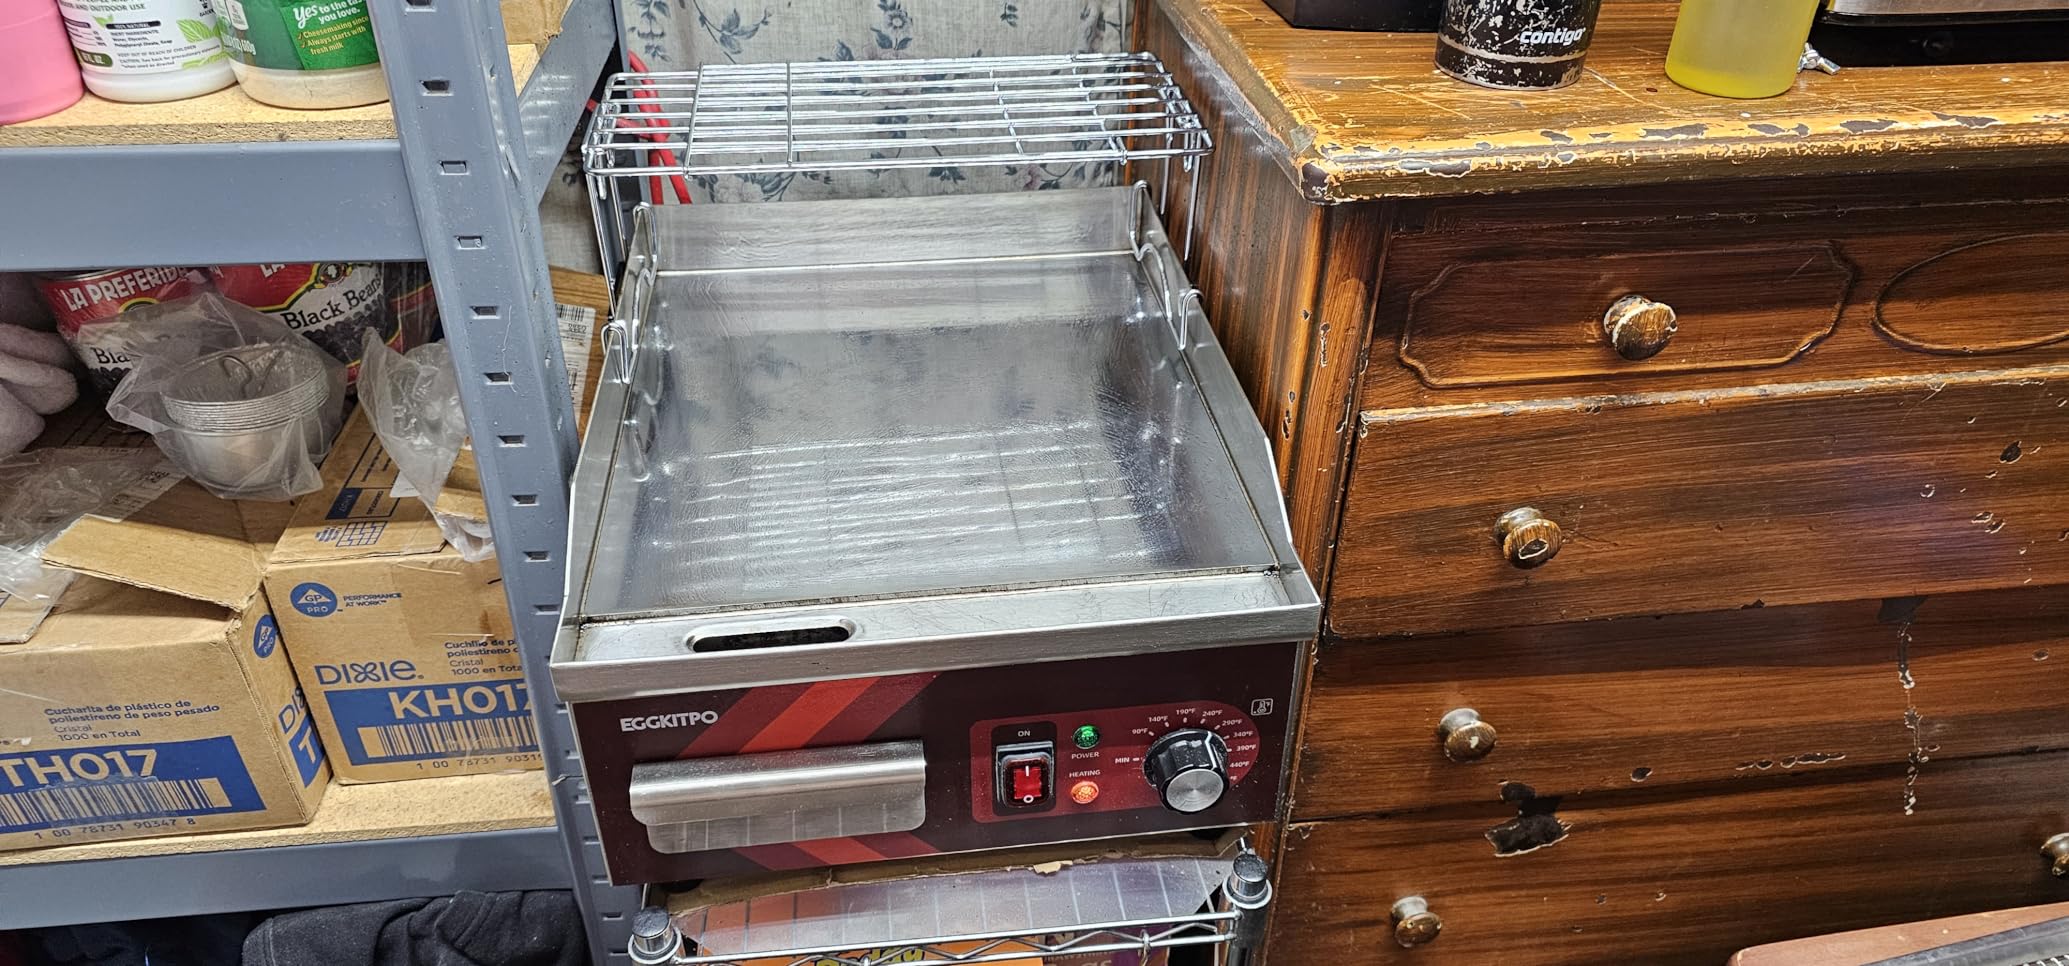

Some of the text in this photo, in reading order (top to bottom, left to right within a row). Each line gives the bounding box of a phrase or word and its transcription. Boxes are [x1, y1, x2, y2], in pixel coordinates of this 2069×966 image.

[90, 4, 128, 12] OUTDOOR
[129, 3, 146, 11] USE
[318, 6, 331, 14] to
[330, 1, 347, 11] the
[318, 6, 361, 25] you love.
[303, 15, 369, 39] Cheesemaking since
[307, 25, 366, 49] Always starts with
[1520, 27, 1584, 46] contigo
[310, 42, 344, 55] fresh milk
[60, 286, 88, 312] LA
[280, 300, 345, 331] Black
[90, 346, 131, 366] Bla
[304, 594, 322, 602] GP
[343, 592, 402, 601] PERFORMANCE
[447, 647, 510, 658] poliestireno
[449, 658, 483, 667] Cristal
[451, 668, 479, 676] 1000
[44, 699, 192, 716] Cucharita de plástico de
[48, 704, 220, 724] poliestireno de peso pesado
[620, 710, 719, 732] EGGKITPO
[54, 724, 92, 733] Cristal
[58, 733, 89, 742] 1000
[111, 729, 141, 738] Total
[1071, 751, 1100, 760] POWER
[1069, 769, 1101, 778] HEATING
[52, 828, 71, 837] 00
[134, 819, 176, 829] 90347
[187, 817, 196, 826] 8
